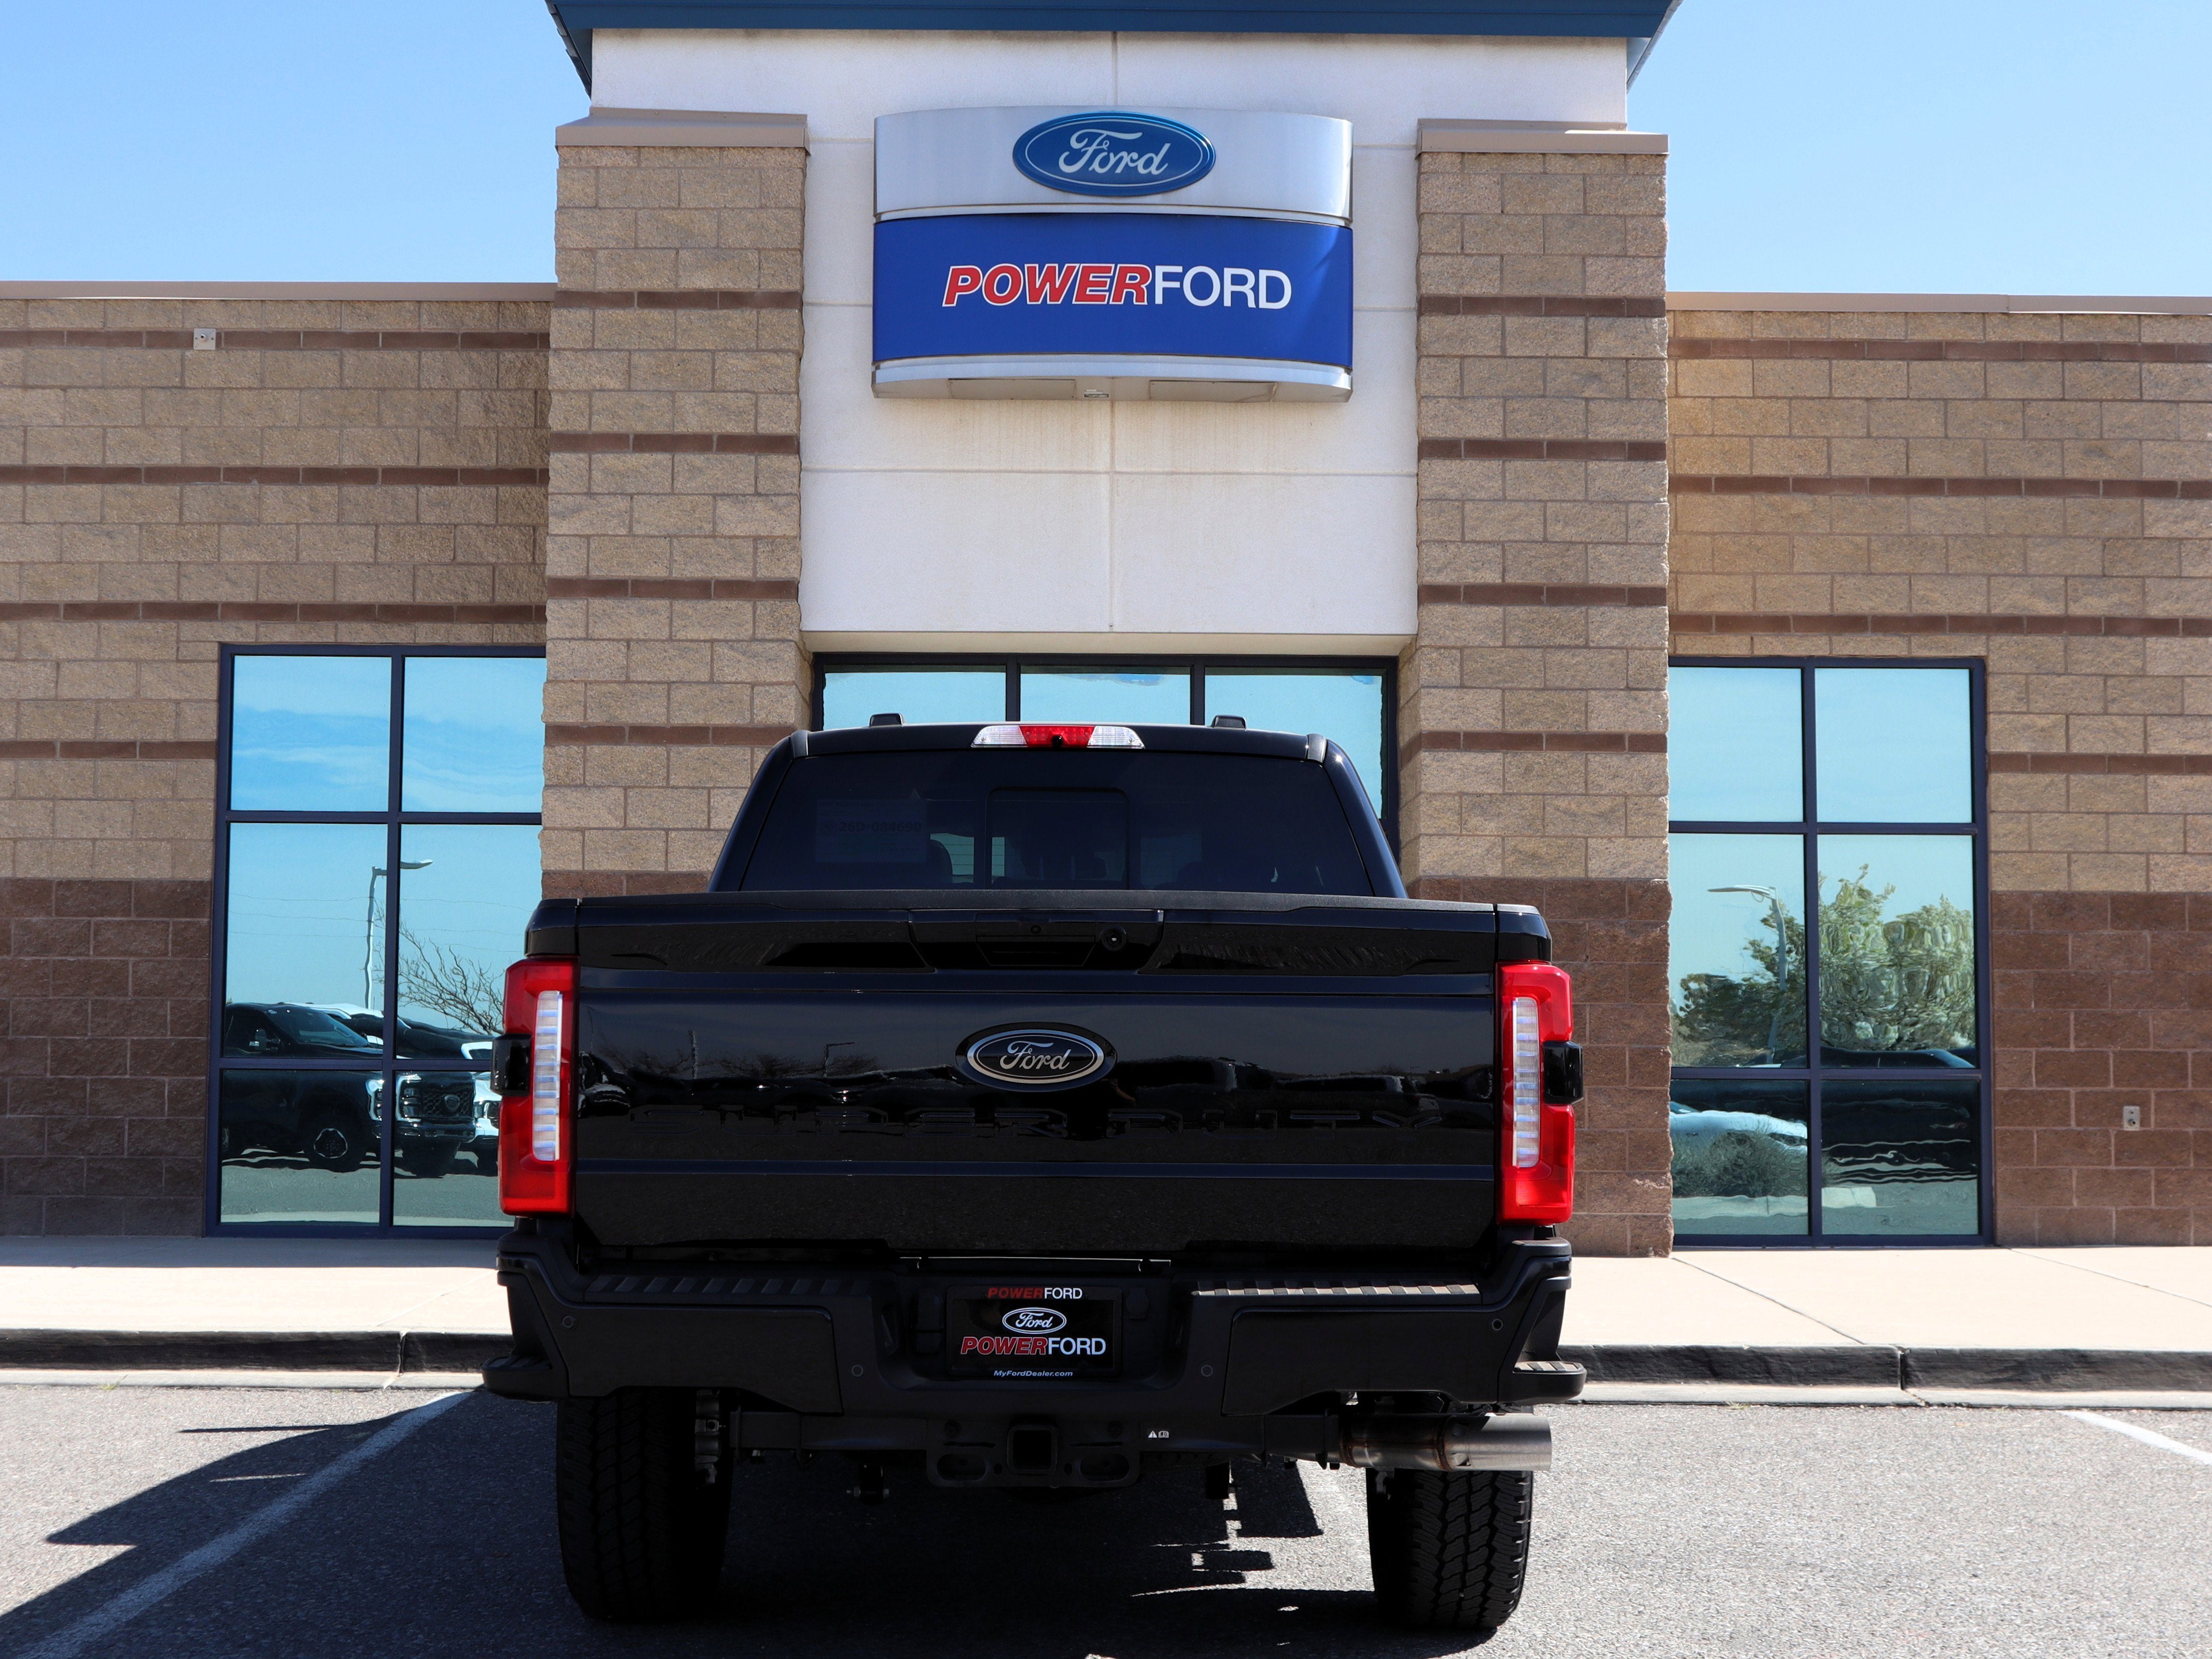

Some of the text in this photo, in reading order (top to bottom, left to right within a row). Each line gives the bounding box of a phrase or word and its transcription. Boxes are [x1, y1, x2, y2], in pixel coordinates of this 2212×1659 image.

[1058, 128, 1170, 175] Ford
[942, 264, 1292, 309] POWERFORD
[1000, 1041, 1072, 1070] Ford
[629, 1104, 1442, 1141] SUPER DUTY
[988, 1287, 1083, 1299] POWERFORD
[1015, 1313, 1054, 1328] Ford
[961, 1336, 1106, 1355] POWERFORD
